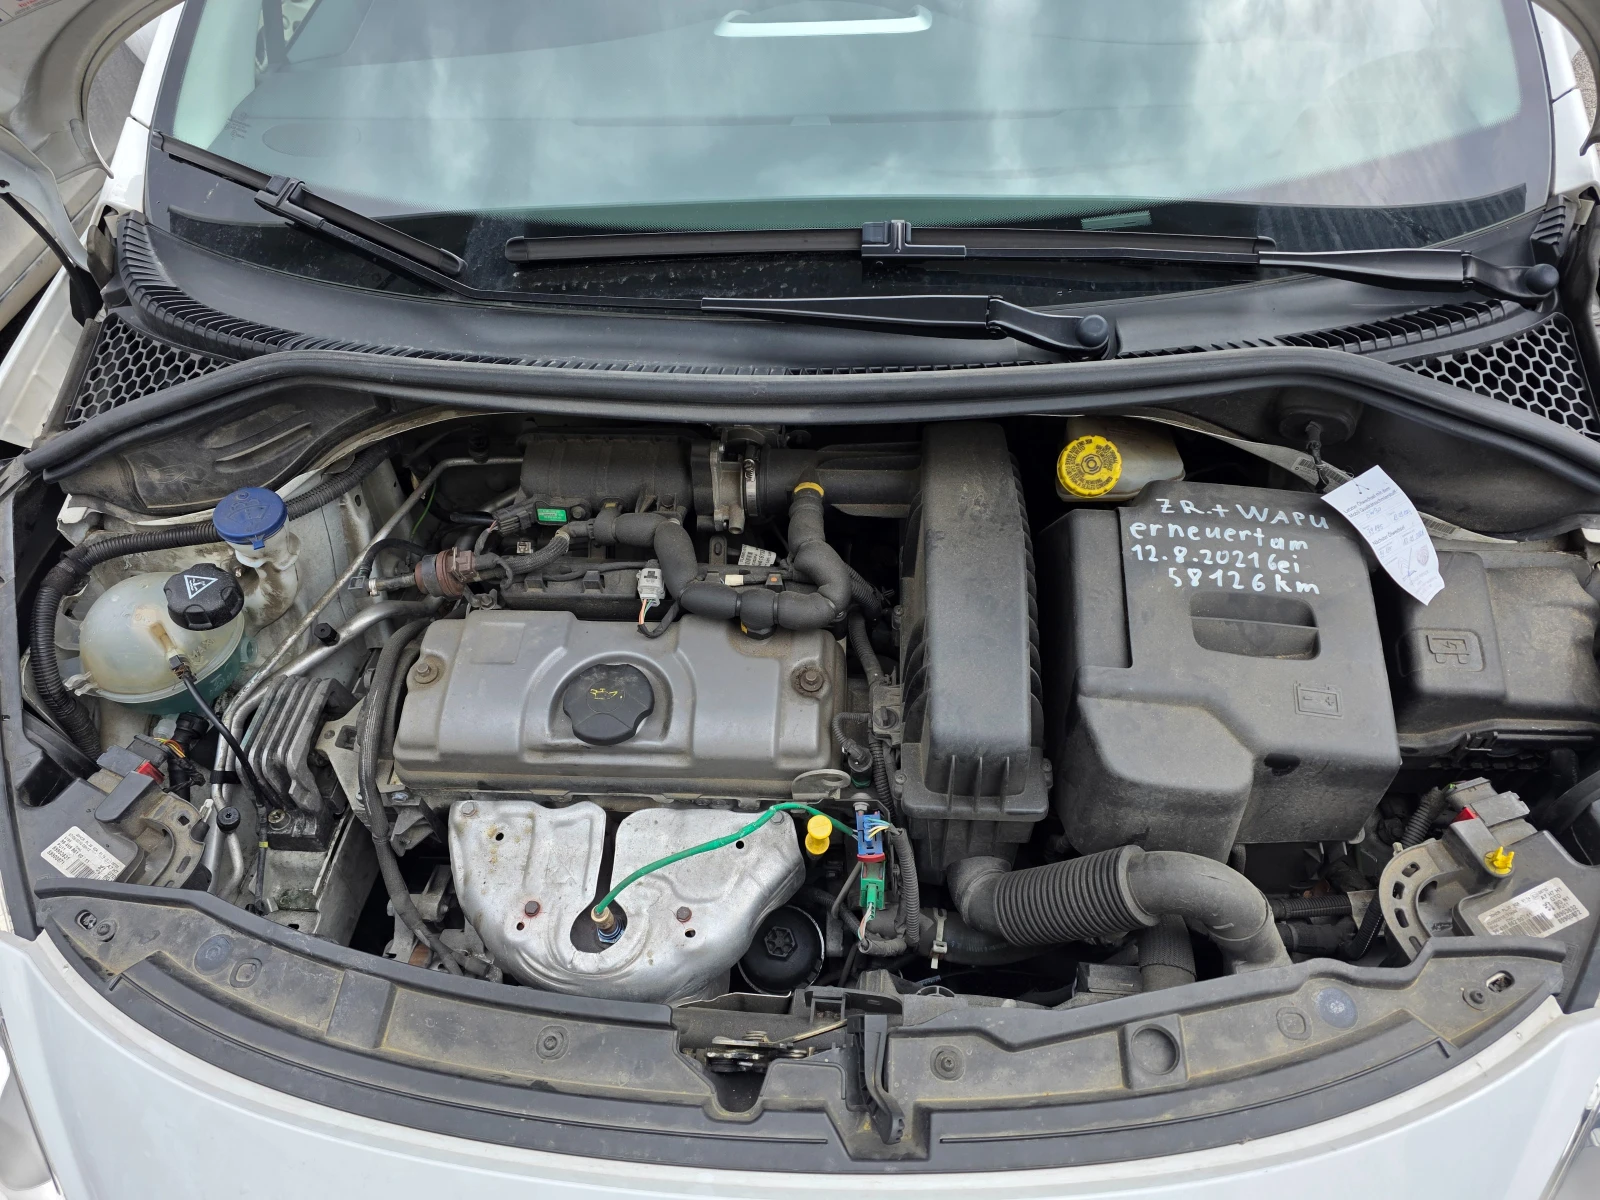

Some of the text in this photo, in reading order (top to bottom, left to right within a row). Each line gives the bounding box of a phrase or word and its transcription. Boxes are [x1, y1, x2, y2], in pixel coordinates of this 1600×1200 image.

[1235, 504, 1329, 529] WAPU
[1130, 522, 1308, 551] erneuert am
[1131, 544, 1259, 568] 12.8.2021
[1168, 567, 1320, 595] 58126 km
